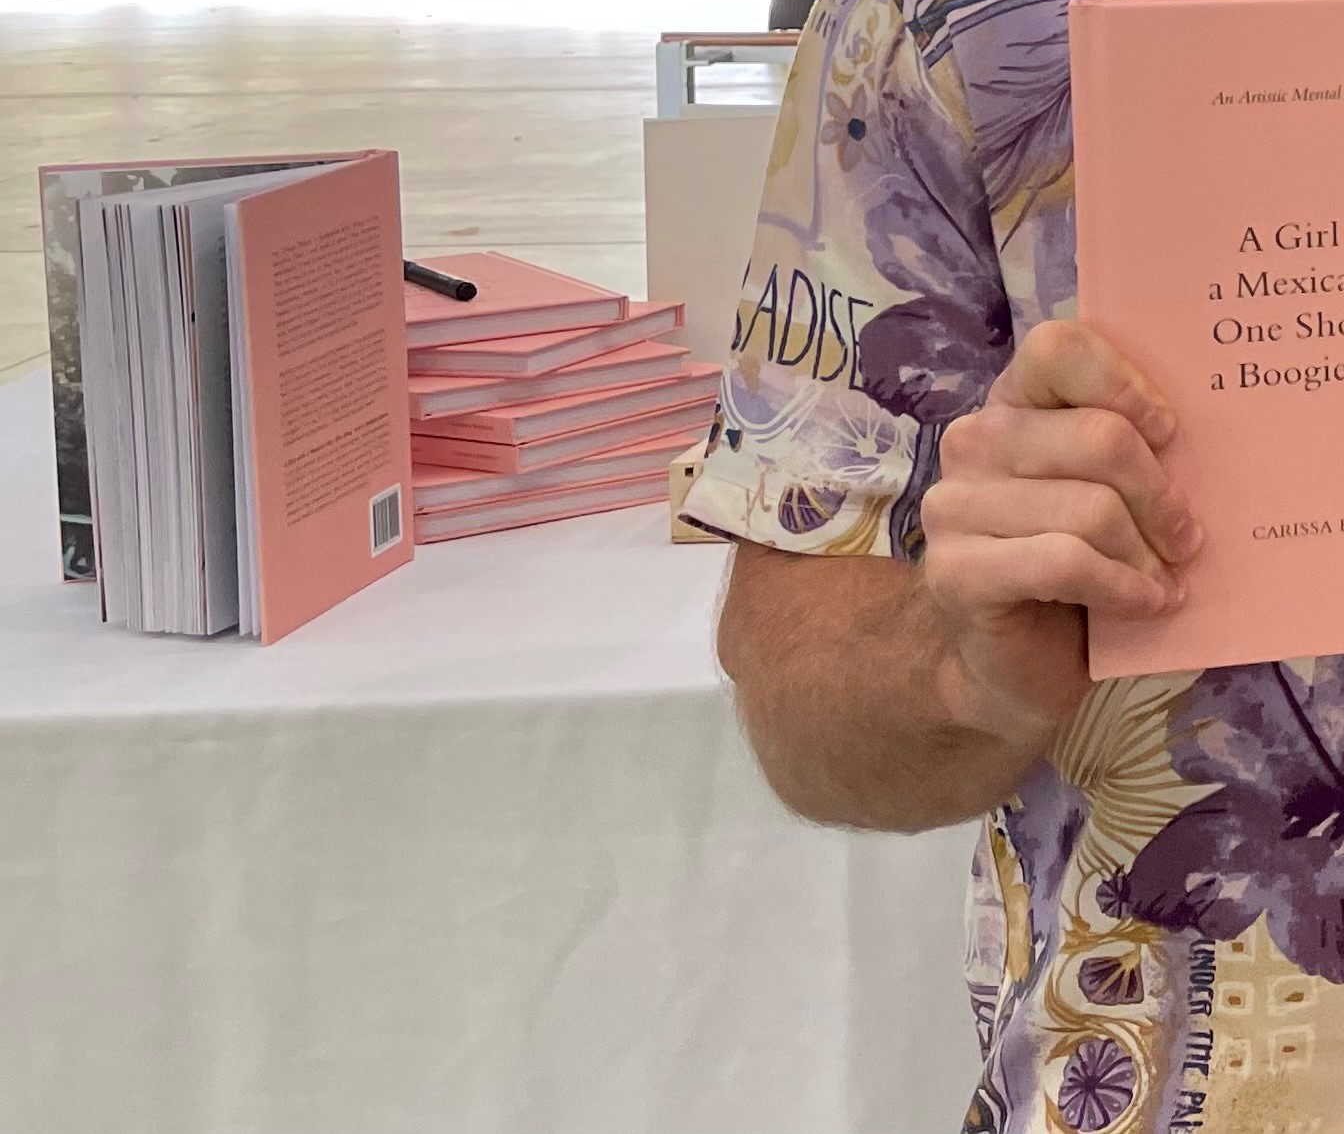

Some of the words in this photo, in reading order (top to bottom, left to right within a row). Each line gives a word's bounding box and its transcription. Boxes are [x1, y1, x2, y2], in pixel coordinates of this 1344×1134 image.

[1211, 90, 1234, 107] An
[1237, 89, 1289, 105] Artistic
[1291, 84, 1342, 102] Mental
[1238, 226, 1264, 253] A
[1274, 220, 1339, 251] Girl
[1208, 282, 1224, 301] a
[731, 257, 874, 390] ADISE
[1212, 317, 1283, 345] One
[1210, 373, 1225, 392] a
[1252, 520, 1333, 541] CARISSA
